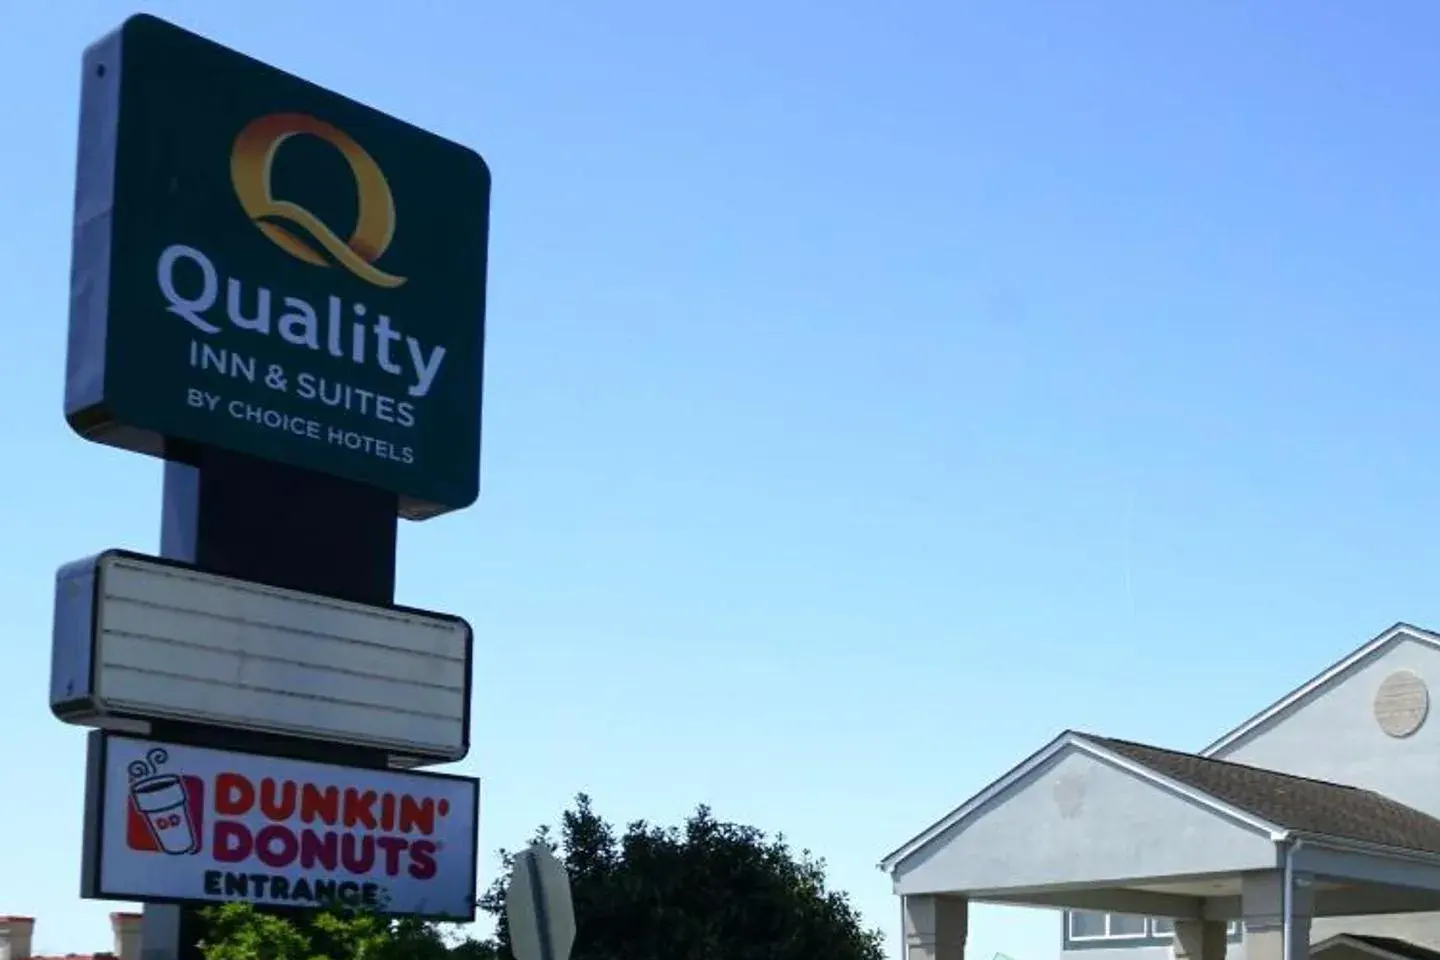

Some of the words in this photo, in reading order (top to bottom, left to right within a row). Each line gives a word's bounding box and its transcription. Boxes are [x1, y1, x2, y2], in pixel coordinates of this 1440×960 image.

[157, 243, 446, 396] Quality
[189, 339, 256, 383] INN
[264, 364, 288, 392] &
[296, 372, 416, 427] SUITES
[187, 388, 220, 411] BY
[228, 400, 321, 440] CHOICE
[327, 426, 414, 464] HOTELS
[214, 771, 450, 836] DUNKIN'
[212, 820, 440, 880] DONUTS
[203, 870, 382, 903] ENTRANCE
